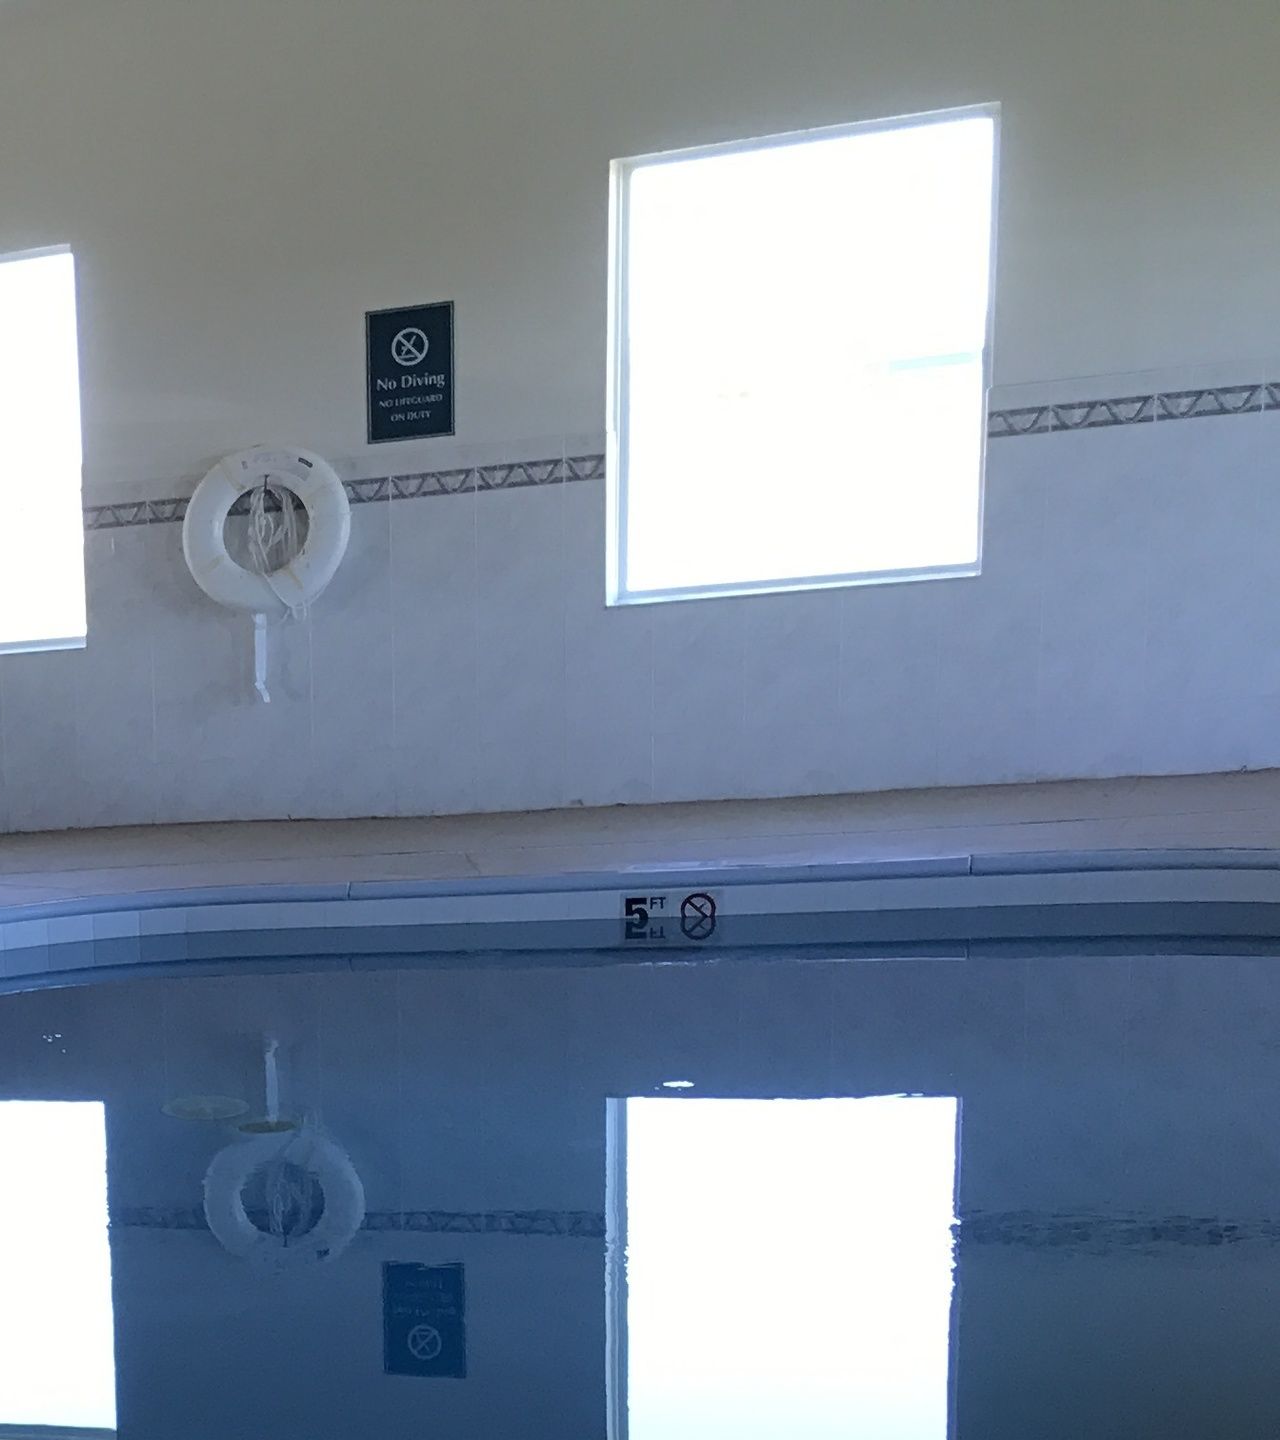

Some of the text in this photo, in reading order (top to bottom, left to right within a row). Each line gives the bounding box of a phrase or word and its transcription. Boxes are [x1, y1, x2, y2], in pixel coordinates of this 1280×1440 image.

[376, 372, 445, 391] No Diving
[379, 400, 393, 408] NO
[390, 410, 431, 421] ON DUTY
[625, 896, 666, 920] 5 FT
